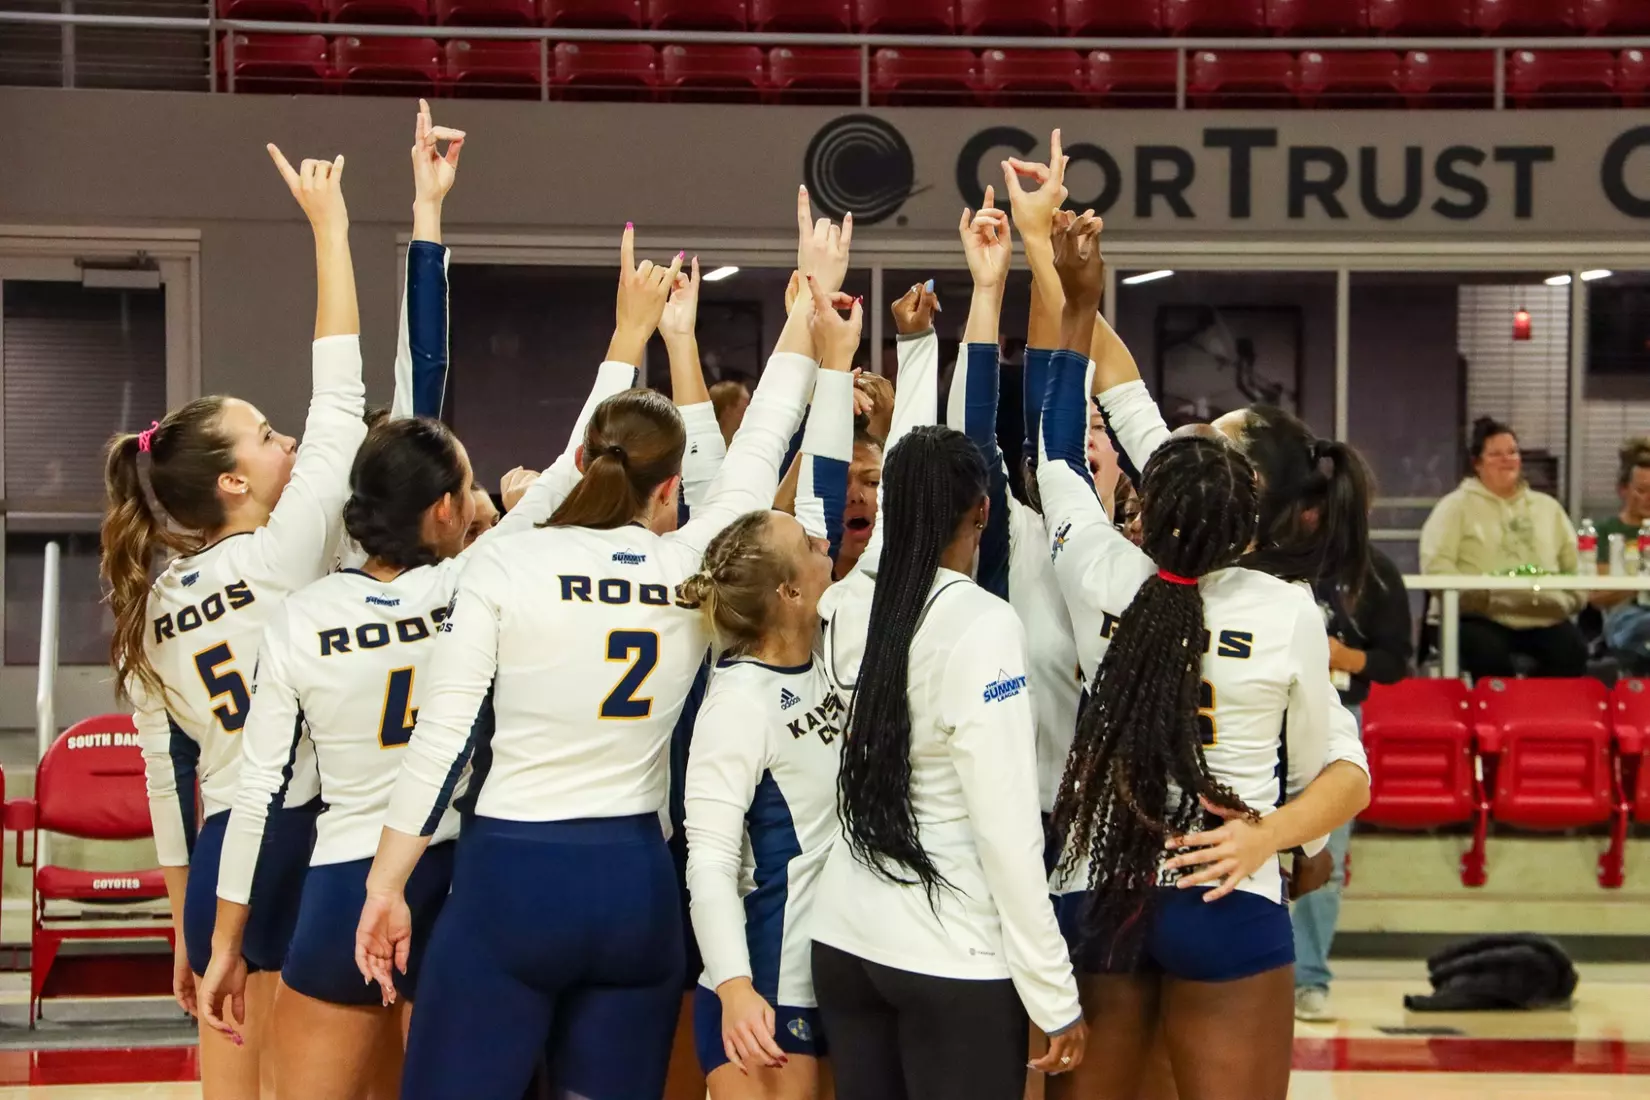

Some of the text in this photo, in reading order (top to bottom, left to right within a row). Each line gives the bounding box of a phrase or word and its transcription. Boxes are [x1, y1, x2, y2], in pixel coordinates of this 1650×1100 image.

[153, 579, 256, 645] ROOS
[192, 639, 251, 735] 5
[598, 628, 661, 721] 2
[983, 675, 1026, 703] SUMMIT
[377, 664, 420, 750] 4
[780, 695, 801, 711] adidas
[67, 733, 112, 750] SOUTH
[92, 878, 141, 890] COYOTES
